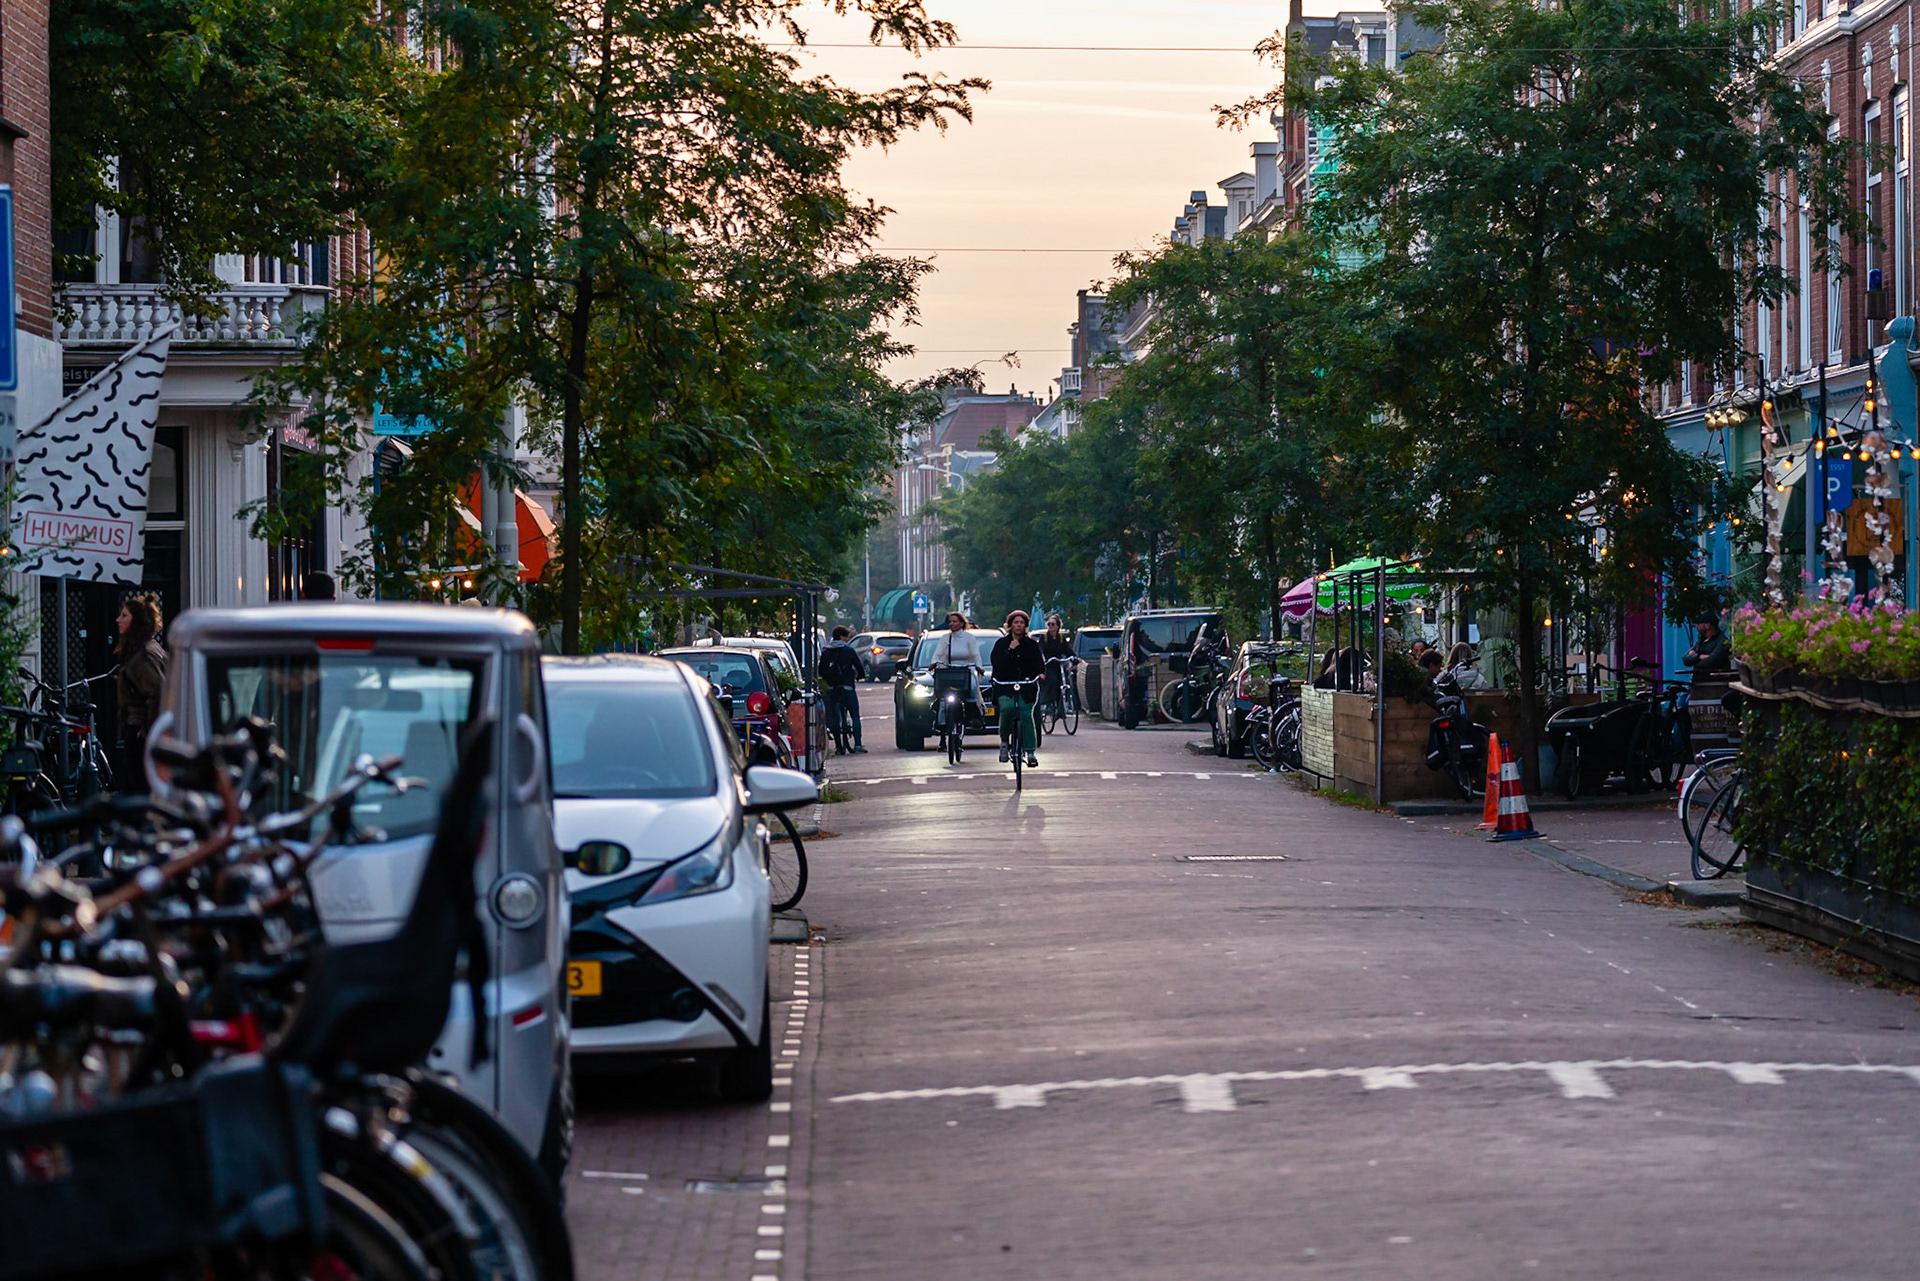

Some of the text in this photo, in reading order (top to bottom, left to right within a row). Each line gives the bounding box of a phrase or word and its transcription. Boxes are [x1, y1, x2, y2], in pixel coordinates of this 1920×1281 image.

[63, 369, 99, 380] elstr
[1830, 463, 1845, 471] 1551
[1827, 476, 1841, 496] P
[31, 519, 125, 547] HUMMUS
[567, 966, 583, 990] 3
